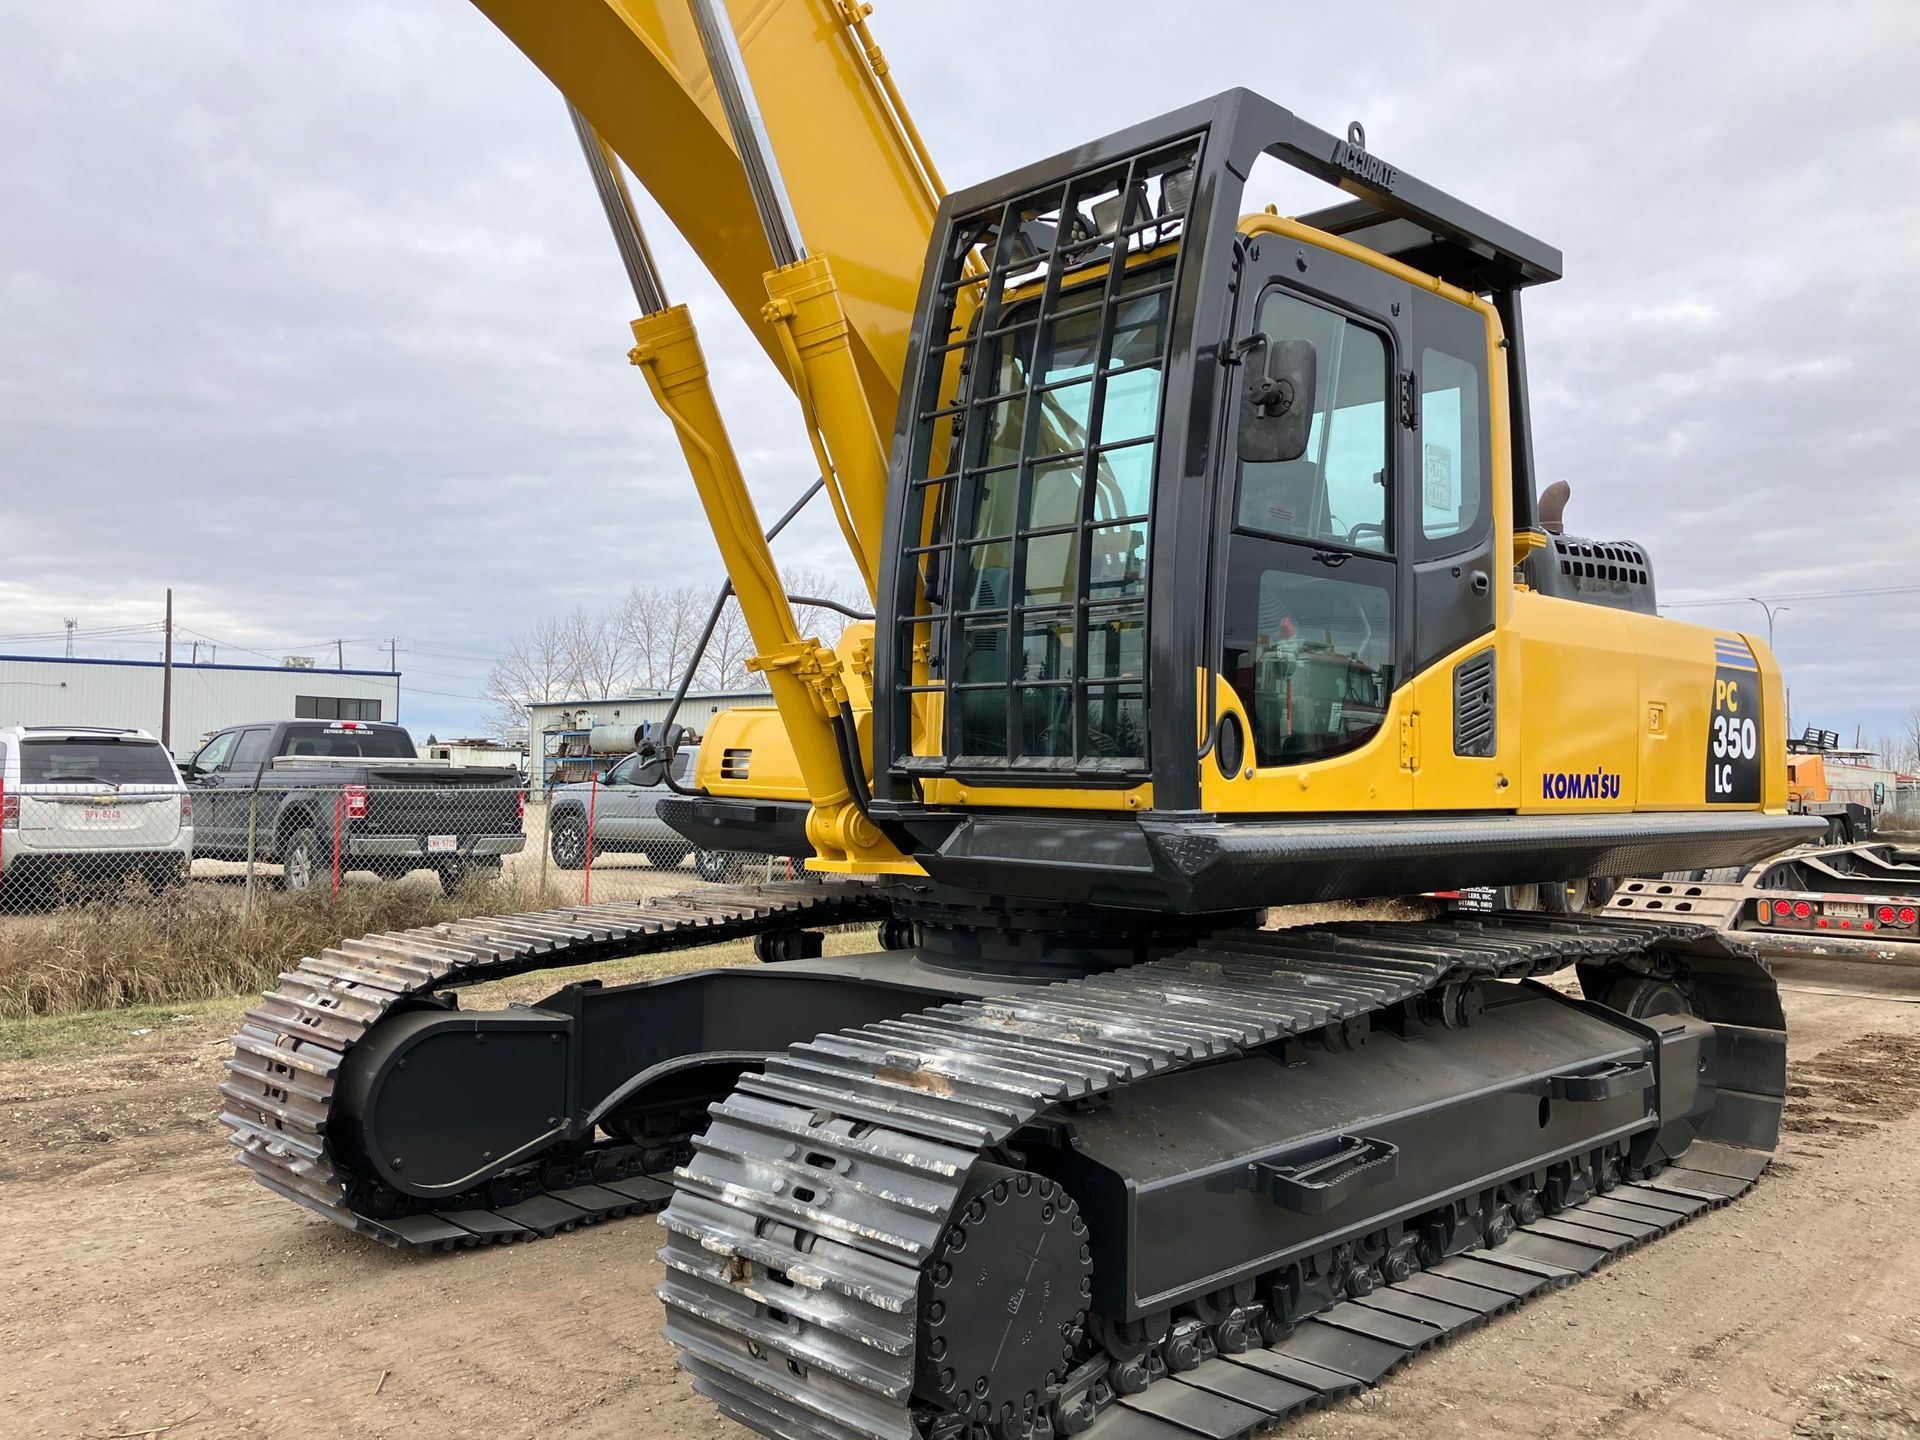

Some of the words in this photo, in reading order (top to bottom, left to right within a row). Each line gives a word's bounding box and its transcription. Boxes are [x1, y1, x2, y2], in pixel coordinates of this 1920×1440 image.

[1335, 140, 1396, 189] ACCURATE
[1716, 680, 1737, 712] PC
[1713, 716, 1756, 759] 350
[1543, 767, 1620, 799] KOMATSU
[1715, 764, 1732, 793] LC
